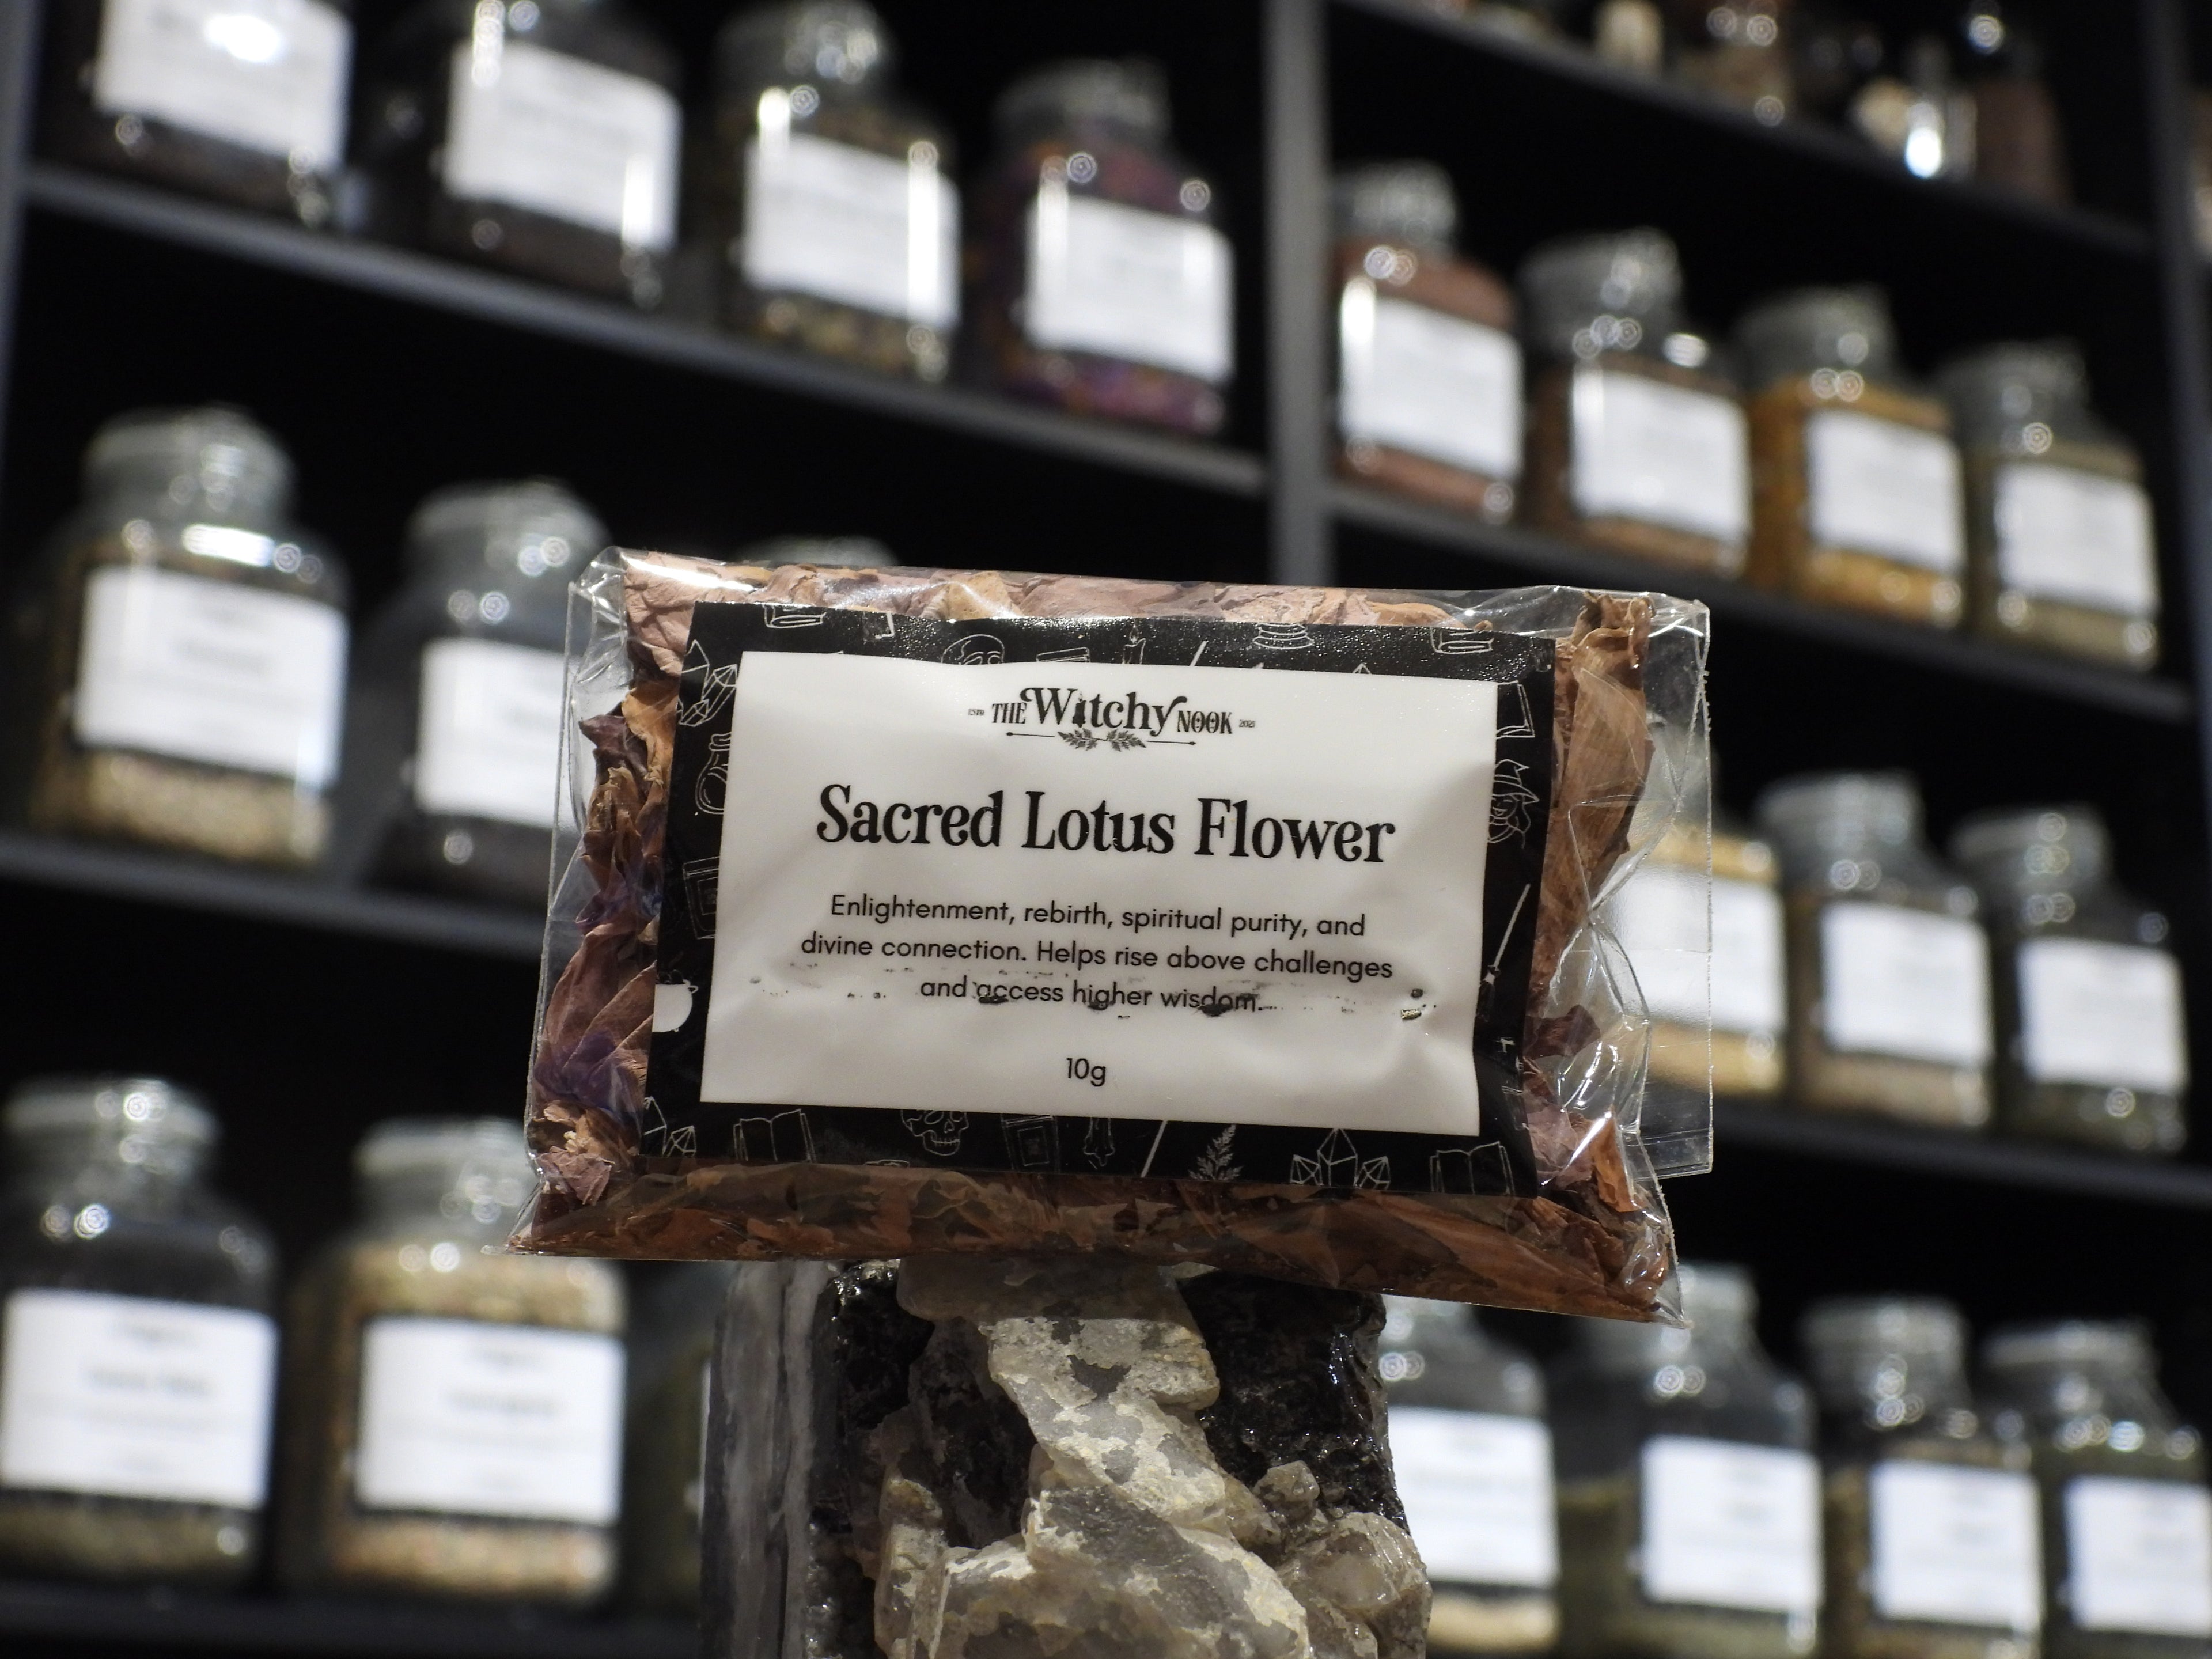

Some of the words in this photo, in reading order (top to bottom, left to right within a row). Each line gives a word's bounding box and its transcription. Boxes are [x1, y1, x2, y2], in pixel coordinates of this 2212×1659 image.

[991, 702, 1028, 724] THE
[1019, 687, 1188, 737] Witchy
[1176, 710, 1233, 734] NOOK
[816, 783, 1004, 847] Sacred
[1021, 790, 1177, 855] Lotus
[1193, 797, 1396, 863] Flower
[831, 893, 1015, 925] Enlightenment,
[1023, 900, 1113, 929] rebirth,
[1121, 907, 1222, 933] spiritual
[1230, 914, 1308, 940] purity,
[1317, 913, 1366, 937] and
[801, 930, 873, 955] divine
[881, 940, 1027, 961] connection.
[1037, 940, 1106, 971] Helps
[1115, 947, 1158, 967] rise
[1166, 945, 1246, 971] above
[1254, 948, 1393, 983] challenges
[921, 976, 968, 998] and
[976, 984, 1064, 1002] access
[1073, 979, 1153, 1010] higher
[1161, 986, 1264, 1012] wisdom.
[1065, 1057, 1107, 1087] 10g
